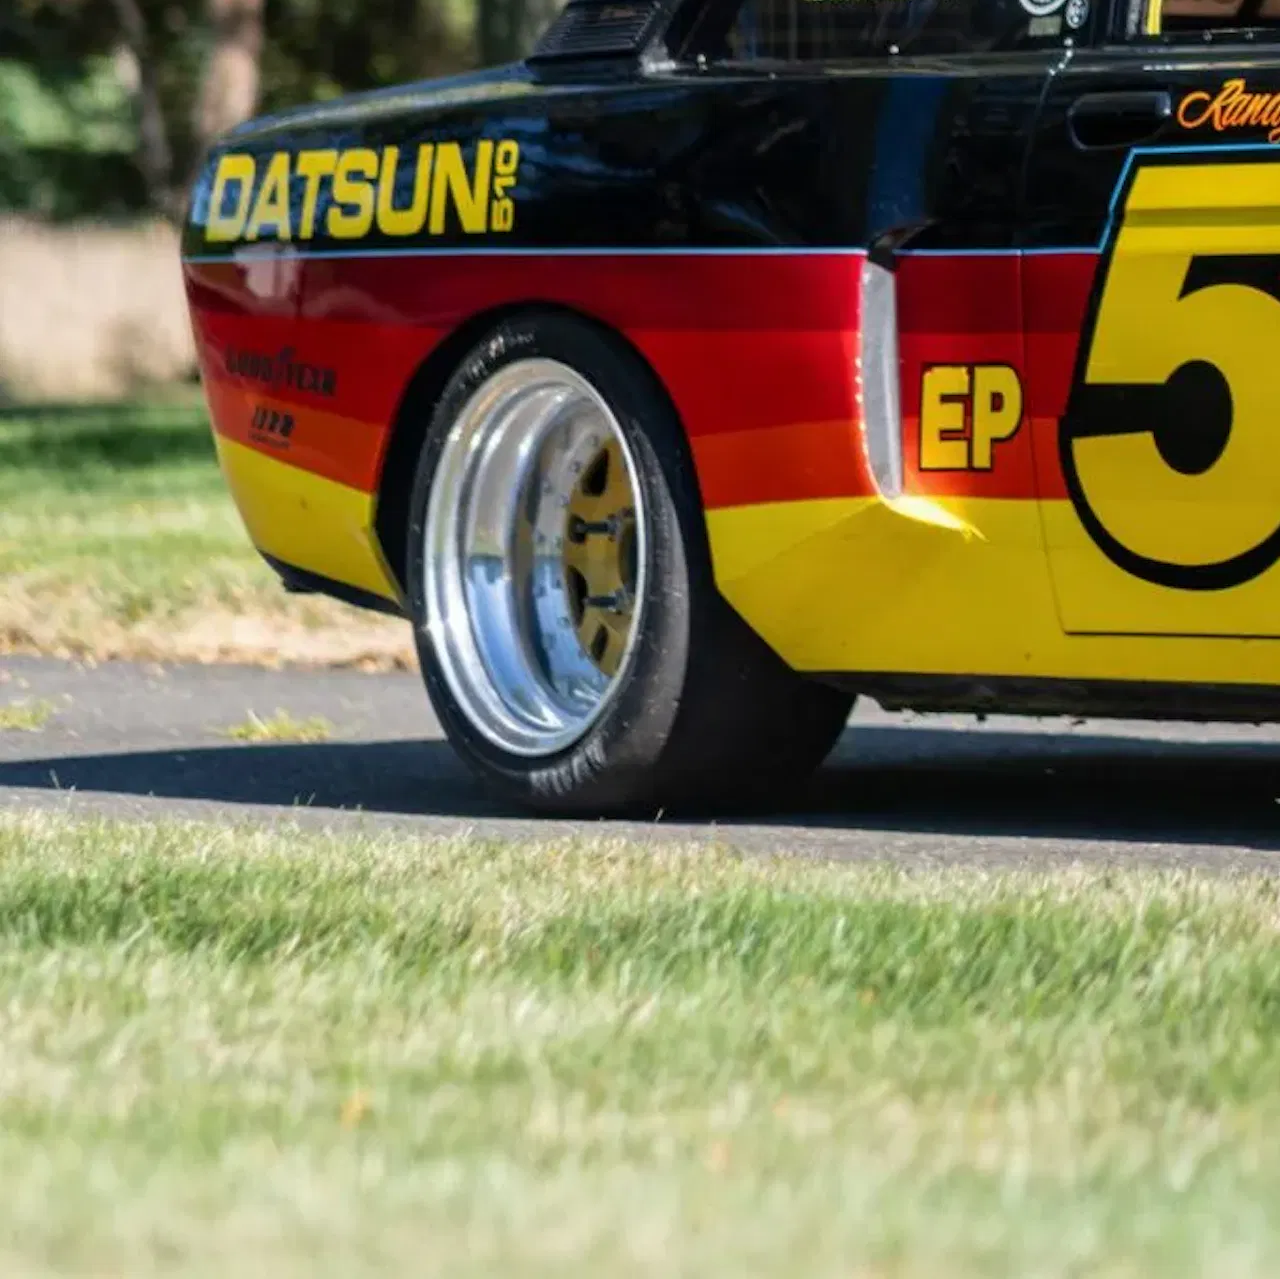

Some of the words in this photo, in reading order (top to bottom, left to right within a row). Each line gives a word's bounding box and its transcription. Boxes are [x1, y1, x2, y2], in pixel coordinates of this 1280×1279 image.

[206, 139, 495, 242] DATSUN
[491, 139, 519, 233] 510
[919, 363, 1024, 472] EP
